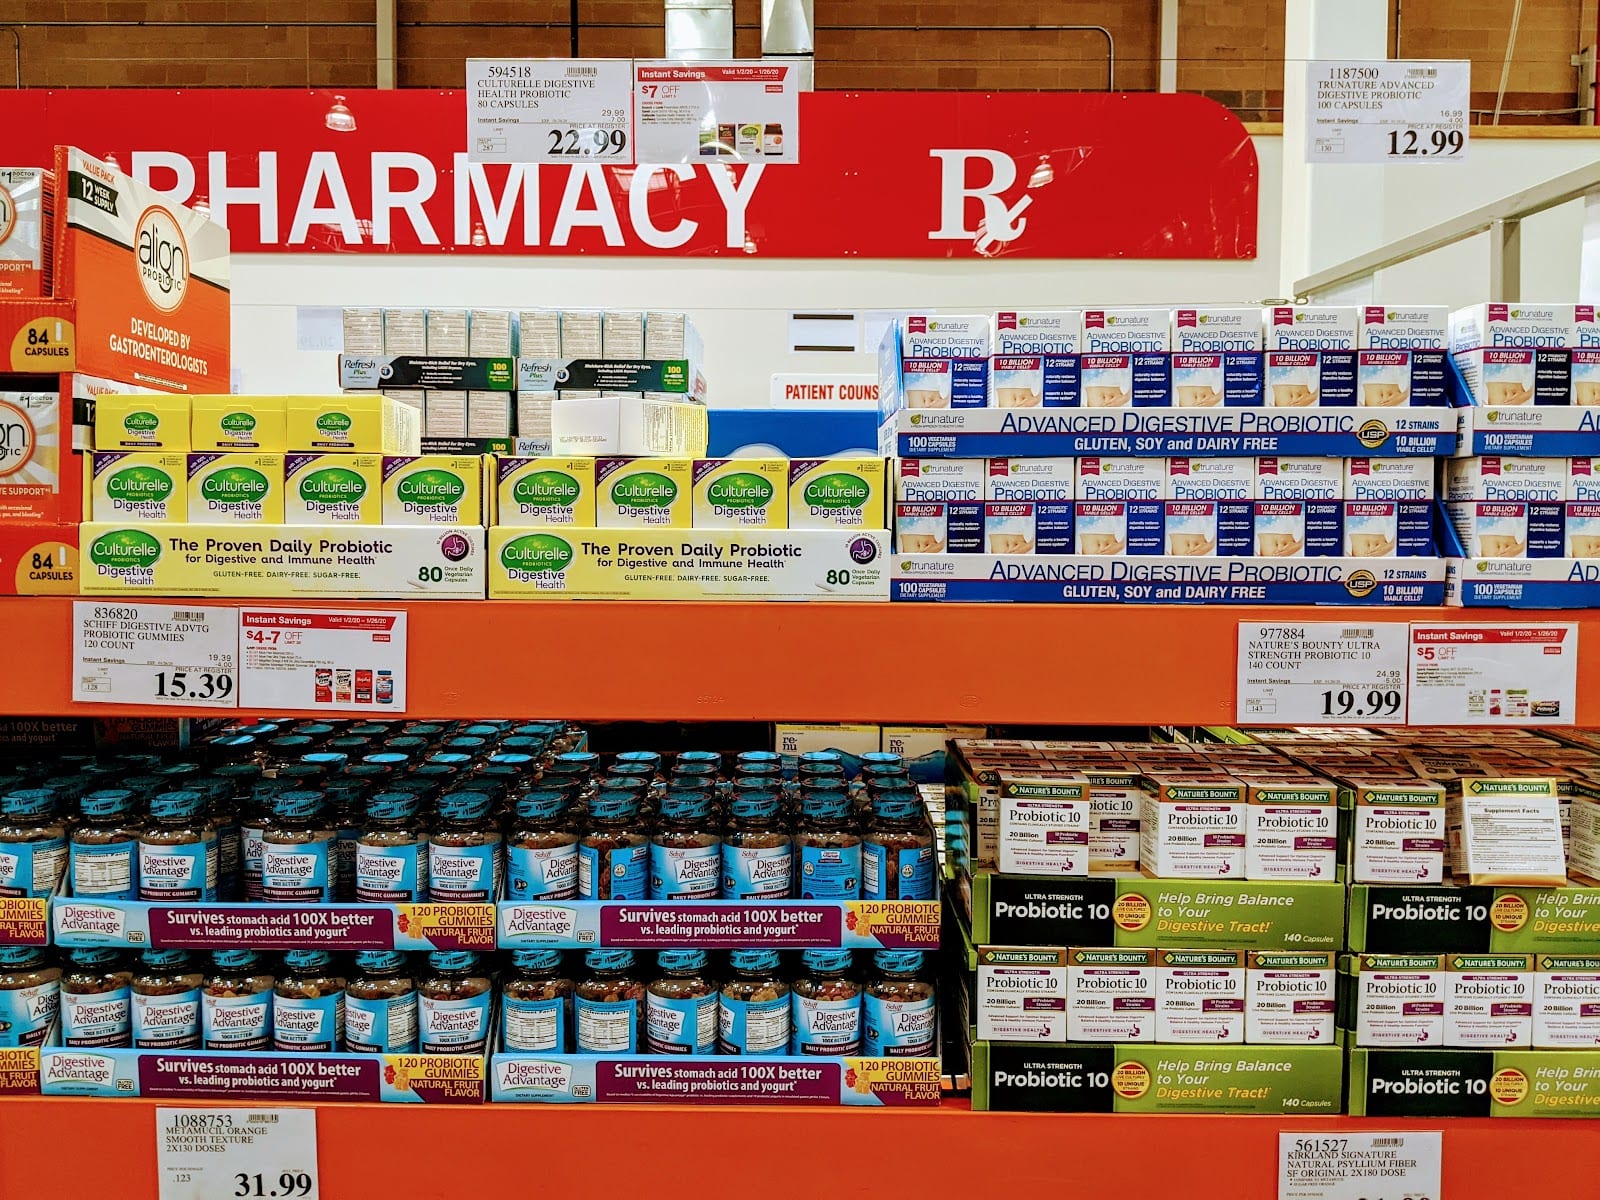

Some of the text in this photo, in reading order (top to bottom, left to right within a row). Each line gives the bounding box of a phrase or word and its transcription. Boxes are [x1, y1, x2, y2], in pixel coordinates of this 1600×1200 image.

[488, 67, 531, 78] 594518
[642, 70, 705, 78] Instant Savings
[1330, 68, 1378, 79] 1187500
[478, 80, 595, 88] CULTURELLE DIGESTIVE
[1318, 80, 1434, 90] TRUNATURE ADVANCED
[478, 90, 571, 98] HEALTH PROBIOTIC
[642, 85, 657, 98] $7
[1318, 90, 1422, 100] DIGESTIVE PROBIOTIC
[1318, 101, 1383, 110] 100 CAPSULES
[548, 130, 626, 155] 22.99
[1387, 130, 1464, 156] 12.99
[82, 160, 115, 185] VALUE PACK
[81, 178, 94, 200] 12
[95, 184, 110, 199] WEEK
[94, 195, 114, 212] SUPPLY
[131, 150, 767, 249] PHARMACY
[139, 224, 185, 293] align
[143, 266, 181, 290] PROBIOTIC
[28, 328, 49, 345] 84
[131, 317, 191, 350] DEVELOPED BY
[25, 347, 69, 356] CAPSULES
[109, 334, 208, 375] GASTROENTEROLOGISTS
[344, 359, 376, 371] Refresh
[786, 385, 834, 400] PATIENT
[921, 412, 1354, 433] trunature ADVANCED DIGESTIVE PROBIOTIC
[1395, 420, 1439, 430] 12 STRAINS
[1362, 430, 1385, 439] USP
[1074, 437, 1278, 452] GLUTEN, SOY and DAIRY FREE
[1395, 436, 1437, 446] 10 BILLION
[302, 480, 362, 494] Culturelle
[306, 501, 359, 513] Digestive
[331, 511, 359, 520] Health
[169, 539, 393, 555] The Proven Daily Probiotic
[186, 554, 333, 565] for Digestive and Immune
[418, 566, 443, 582] 80
[94, 607, 138, 620] 836820
[83, 620, 209, 633] SCHIFF DIGESTIVE ADVTG
[83, 630, 185, 642] PROBIOTIC GUMMIES
[246, 630, 303, 644] $4-7 OFF
[1260, 628, 1305, 640] 977884
[83, 640, 135, 650] 120 COUNT
[1248, 641, 1380, 650] NATURE'S BOUNTY ULTRA
[208, 654, 231, 662] 19.39
[1248, 651, 1301, 660] STRENGTH
[1304, 651, 1359, 660] PROBIOTIC
[1416, 647, 1457, 660] $5 OFF
[1248, 661, 1301, 670] 140 COUNT
[154, 671, 233, 700] 15.39
[1321, 690, 1401, 716] 19.99
[783, 743, 797, 751] nu
[513, 908, 566, 922] Digestive
[860, 904, 939, 914] 120 PROBIOTIC
[619, 908, 823, 923] Survives stomach acid 100X better
[886, 914, 939, 924] GUMMIES
[508, 920, 571, 933] Advantage
[641, 925, 654, 935] vs.
[656, 924, 692, 936] leading
[694, 923, 742, 936] probiotics
[743, 924, 761, 935] and
[871, 926, 940, 934] NATURAL FRUIT
[904, 933, 940, 942] FLAVOR
[996, 953, 1027, 961] NATURE'S
[1157, 1060, 1292, 1073] Help Bring Balance
[994, 1071, 1109, 1088] Probiotic 10
[1157, 1074, 1209, 1085] to Your
[1156, 1087, 1225, 1100] Digestive
[1282, 1098, 1331, 1107] 140 Capsules
[174, 1114, 232, 1127] 1088753
[166, 1127, 268, 1135] METAMUCIL ORANGE
[166, 1136, 253, 1144] SMOOTH TEXTURE
[1295, 1139, 1348, 1152] 561527
[1287, 1151, 1397, 1159] KIRKLAND SIGNATURE
[1287, 1160, 1417, 1168] NATURAL PSYLLIUM FIBER
[1287, 1169, 1406, 1177] SF ORIGINAL 2X180 DOSE
[234, 1173, 312, 1197] 31.99
